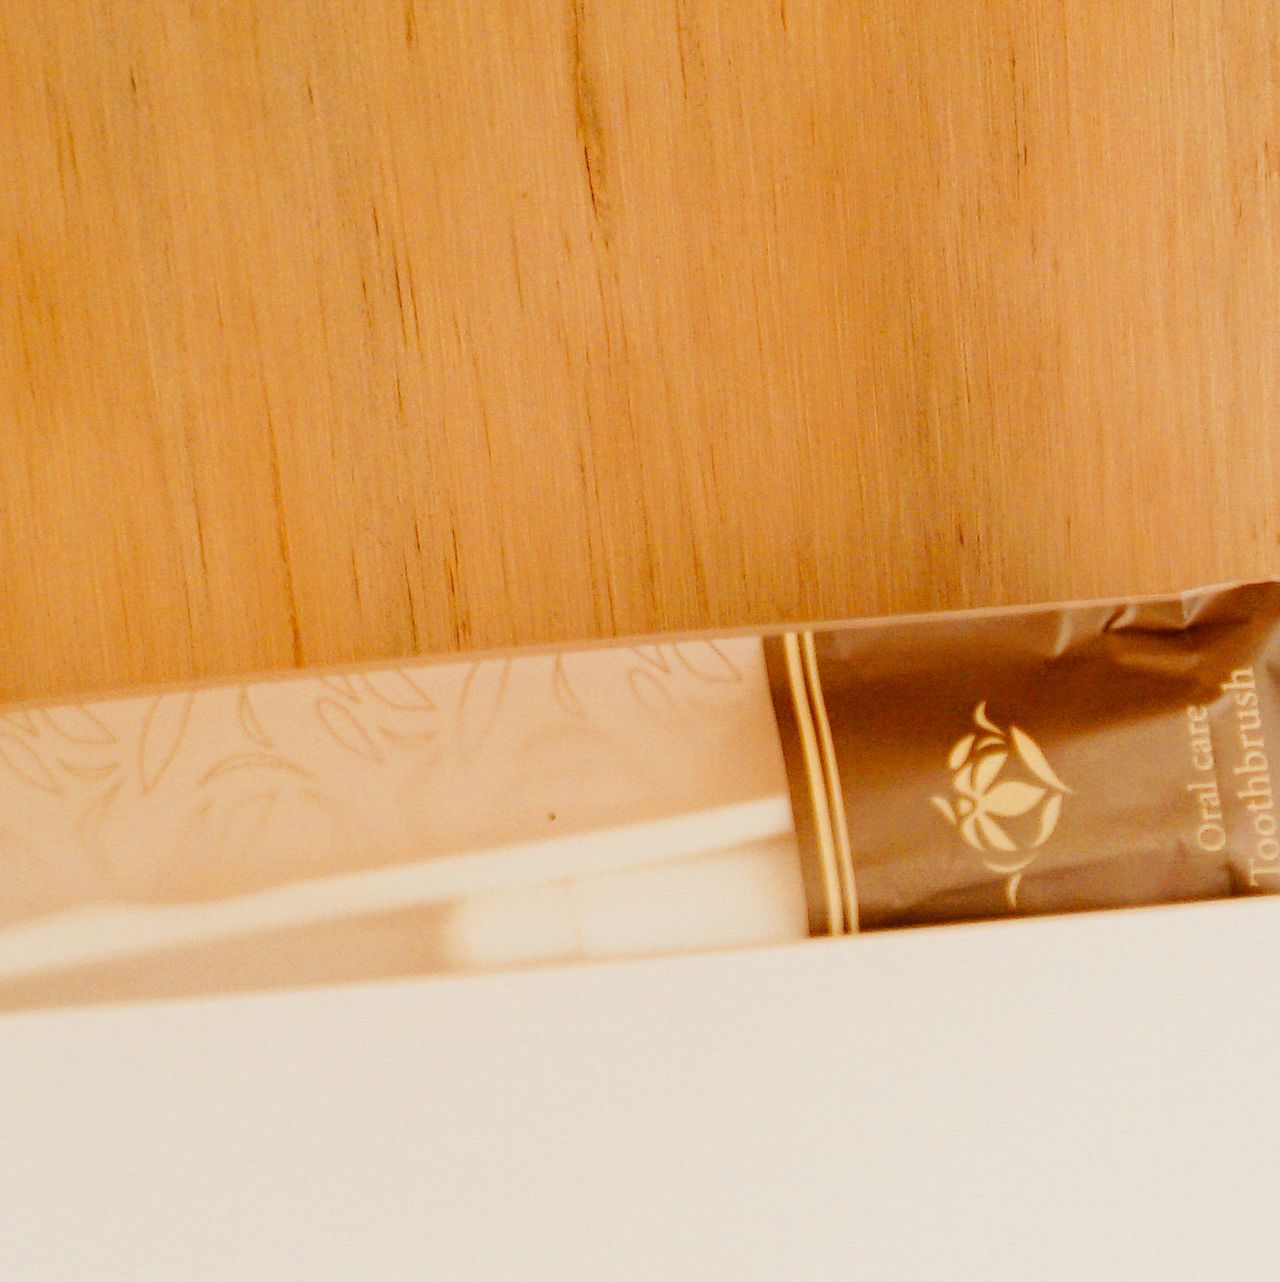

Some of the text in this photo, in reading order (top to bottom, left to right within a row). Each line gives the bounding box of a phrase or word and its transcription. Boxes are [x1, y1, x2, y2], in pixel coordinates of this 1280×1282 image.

[1187, 704, 1227, 852] Oral care
[1221, 667, 1280, 887] Toothbrush
